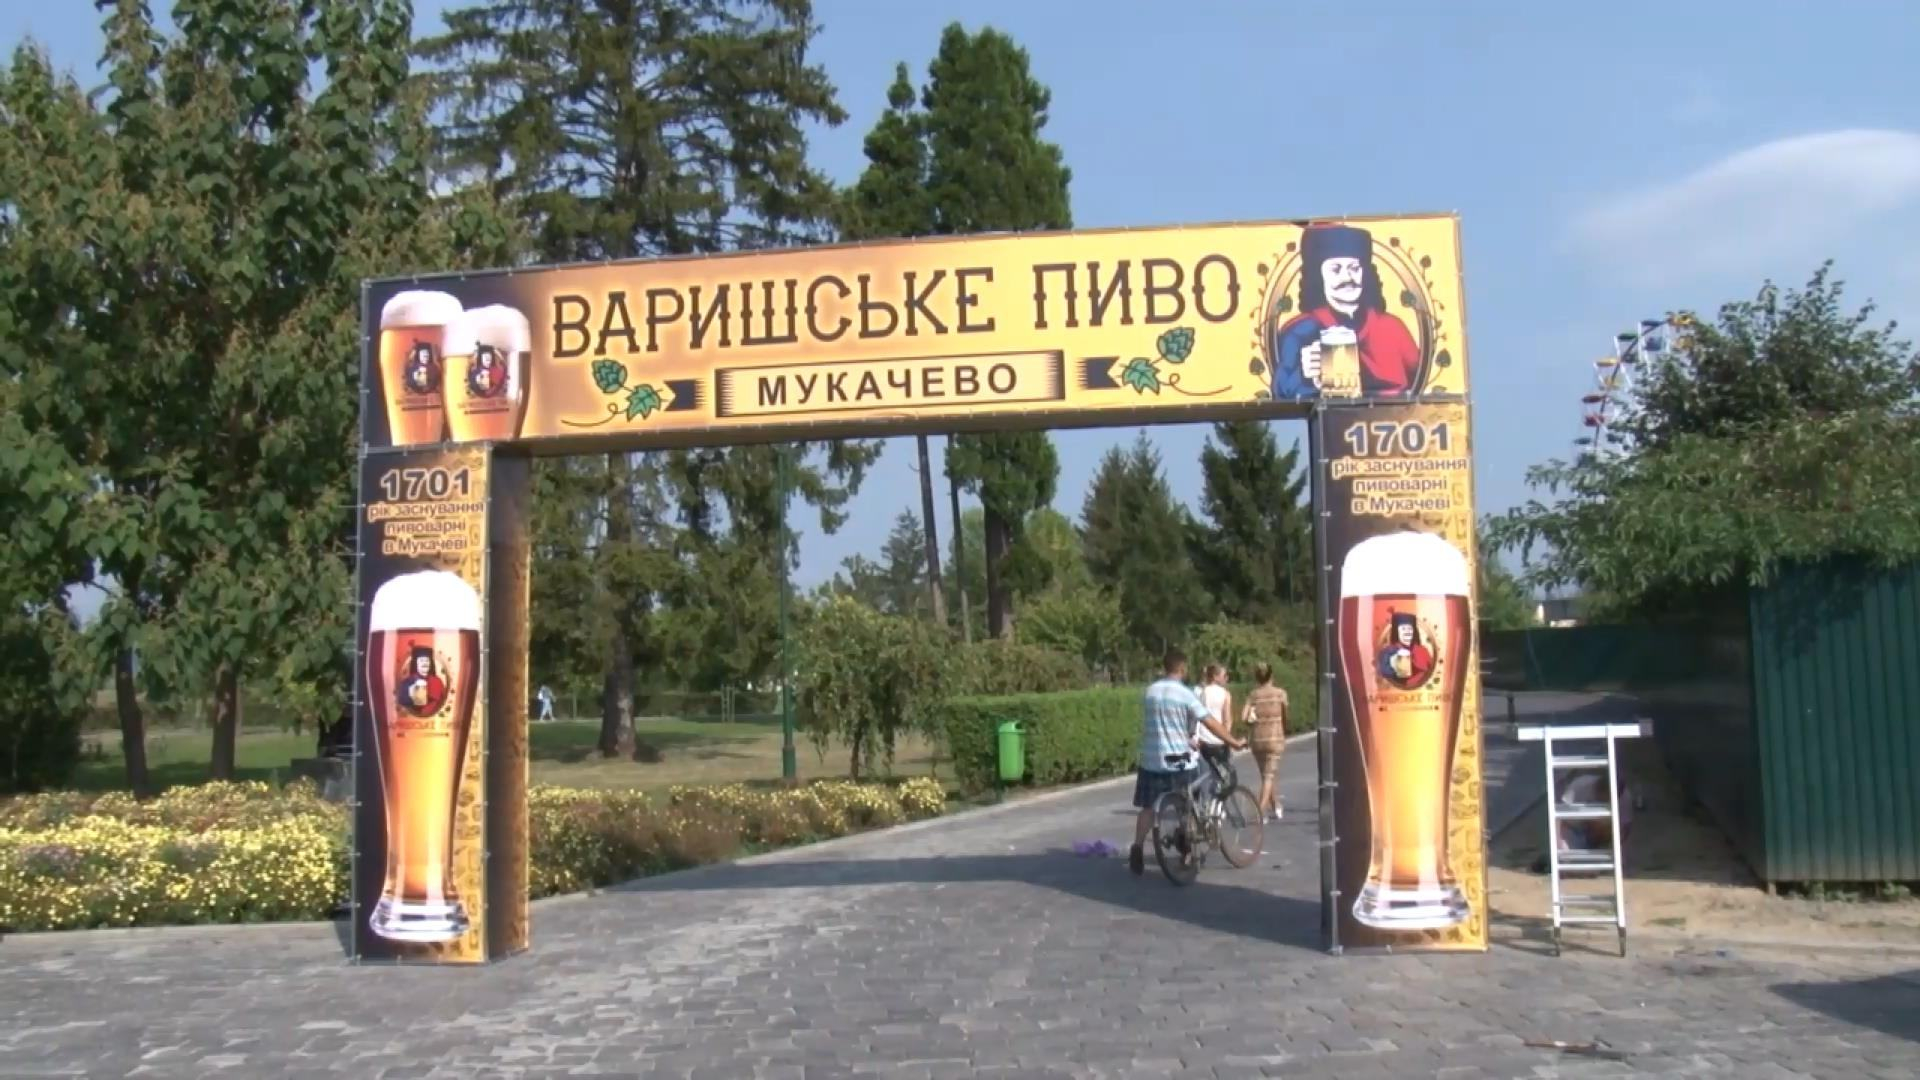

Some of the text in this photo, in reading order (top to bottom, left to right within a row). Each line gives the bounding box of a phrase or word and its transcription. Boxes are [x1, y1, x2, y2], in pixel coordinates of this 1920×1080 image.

[553, 254, 1241, 358] ВАРИШСЬКЕ ПИВО
[757, 363, 1018, 408] МУКАЧЕВО
[1344, 420, 1451, 456] 1701
[1332, 456, 1468, 480] рік заснування
[380, 466, 472, 500] 1701
[1353, 476, 1448, 495] пивоварні
[1352, 495, 1451, 517] в Мукачеві
[398, 535, 468, 558] Мукачеві
